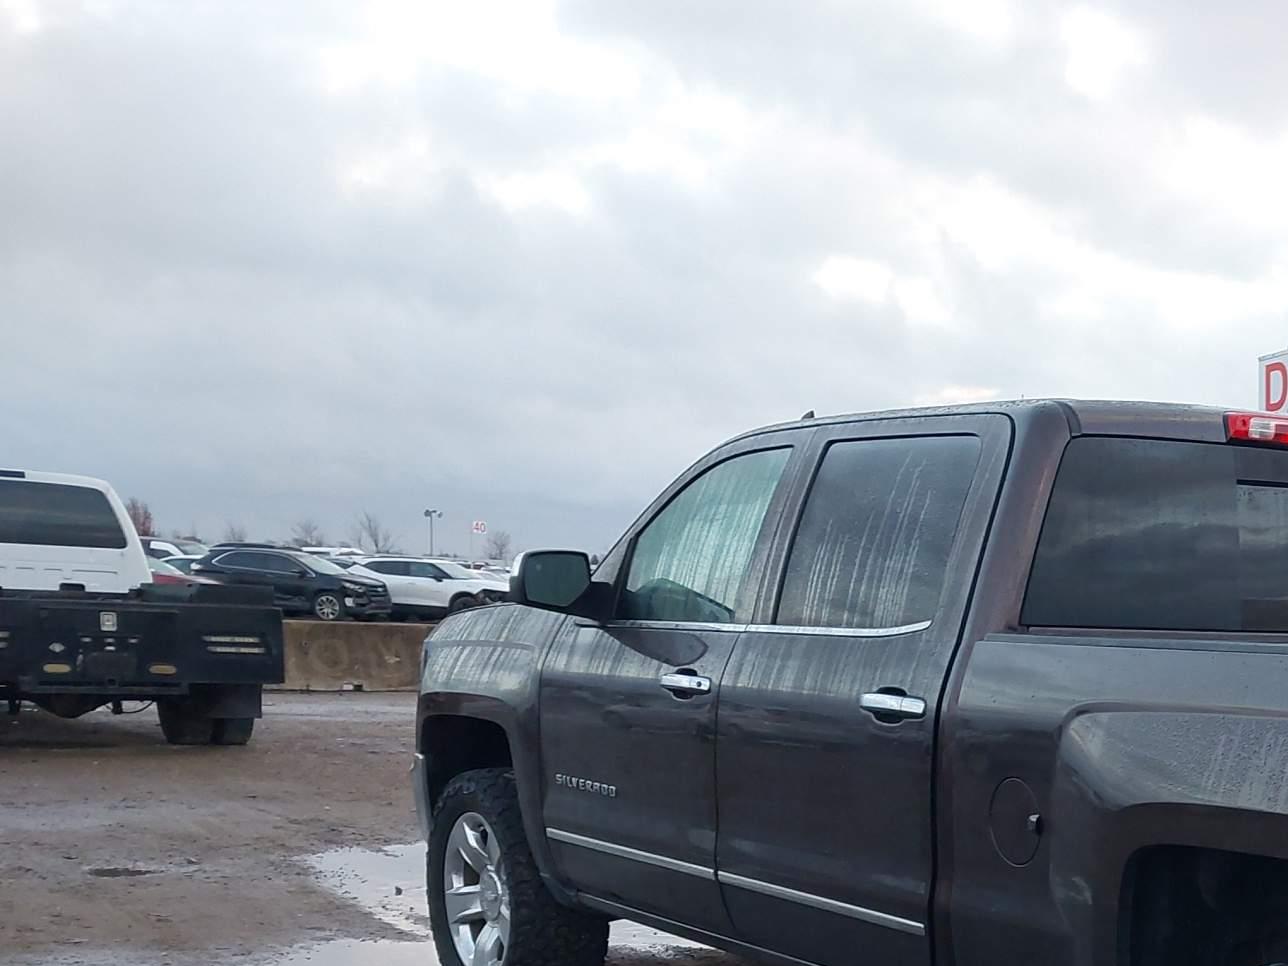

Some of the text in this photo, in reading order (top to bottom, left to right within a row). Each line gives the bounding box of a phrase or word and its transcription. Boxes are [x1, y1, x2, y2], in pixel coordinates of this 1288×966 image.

[1265, 361, 1288, 412] D
[473, 522, 486, 533] 40
[555, 773, 617, 798] SILVERADO
